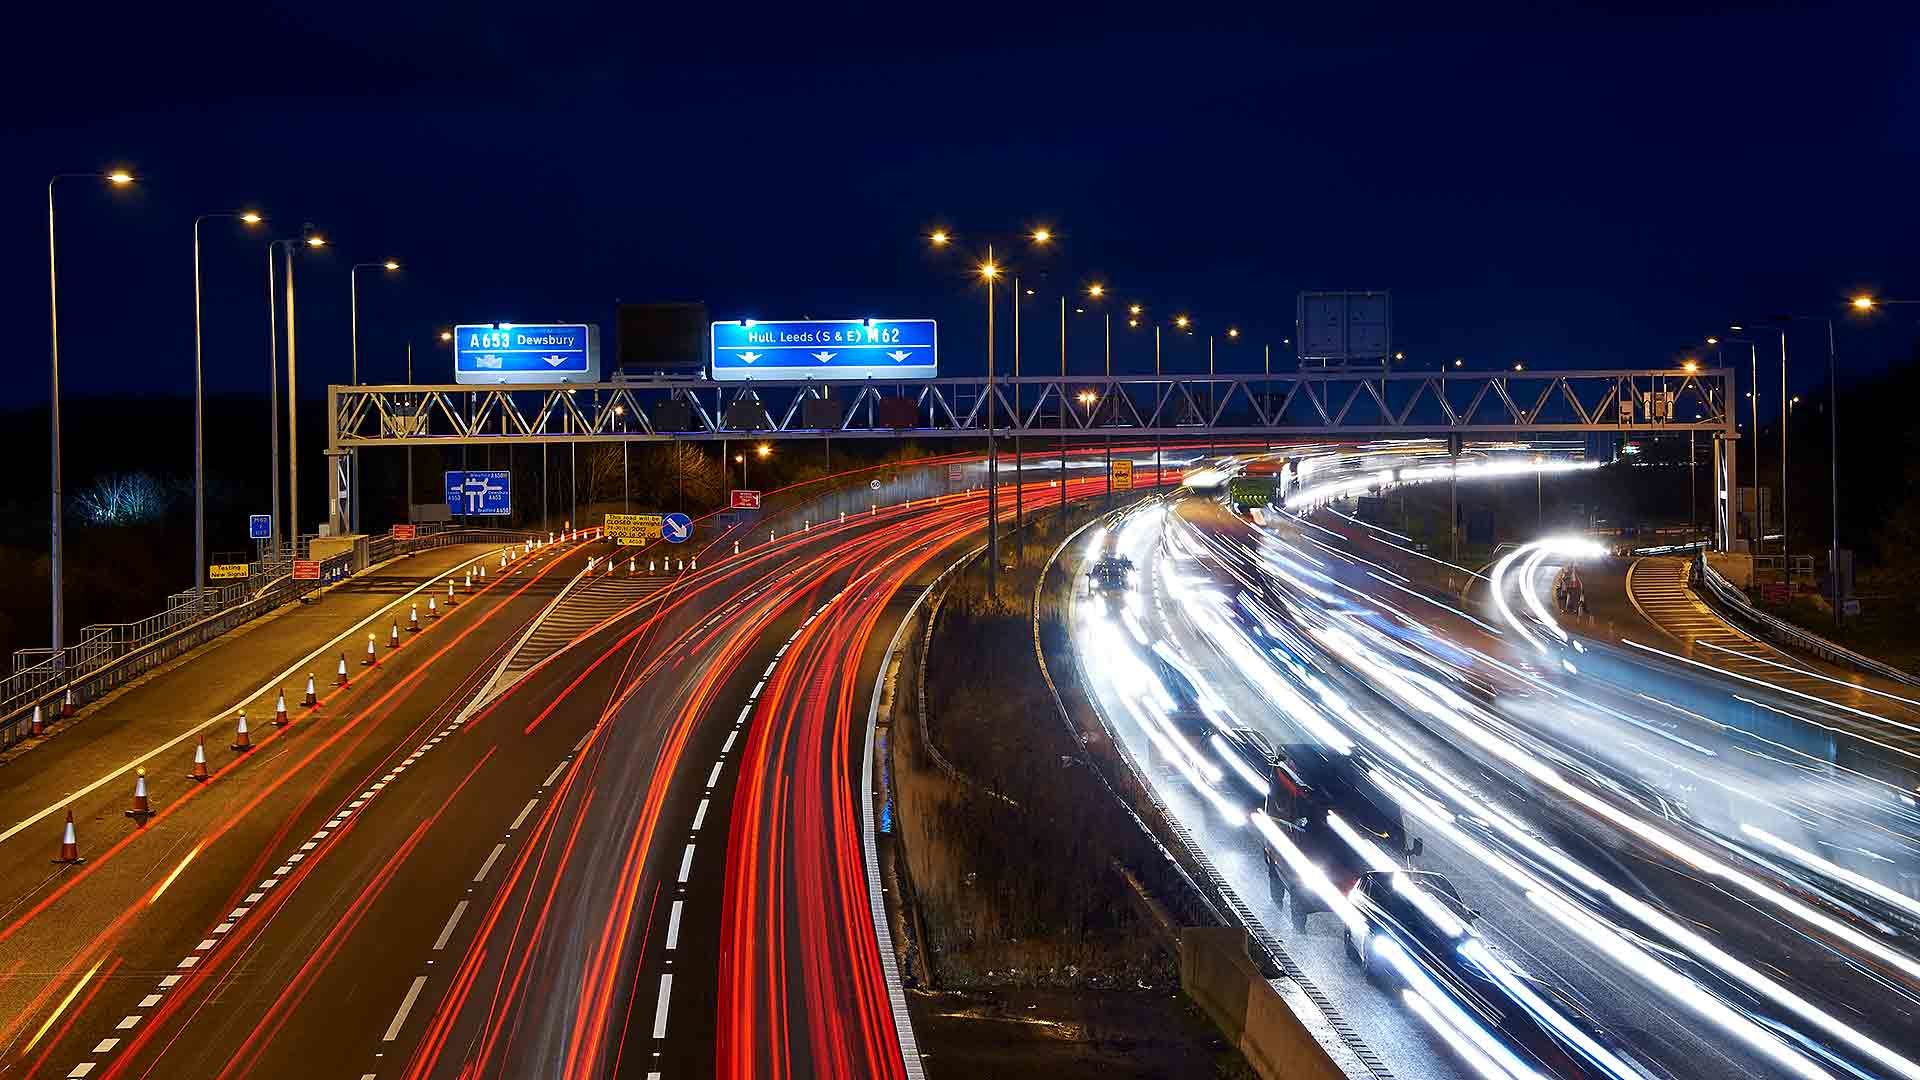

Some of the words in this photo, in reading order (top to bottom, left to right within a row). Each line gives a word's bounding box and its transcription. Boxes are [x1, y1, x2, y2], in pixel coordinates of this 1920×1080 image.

[470, 333, 510, 348] A653
[517, 334, 575, 347] Dewsbury
[780, 331, 813, 342] Leeds
[834, 331, 843, 342] &
